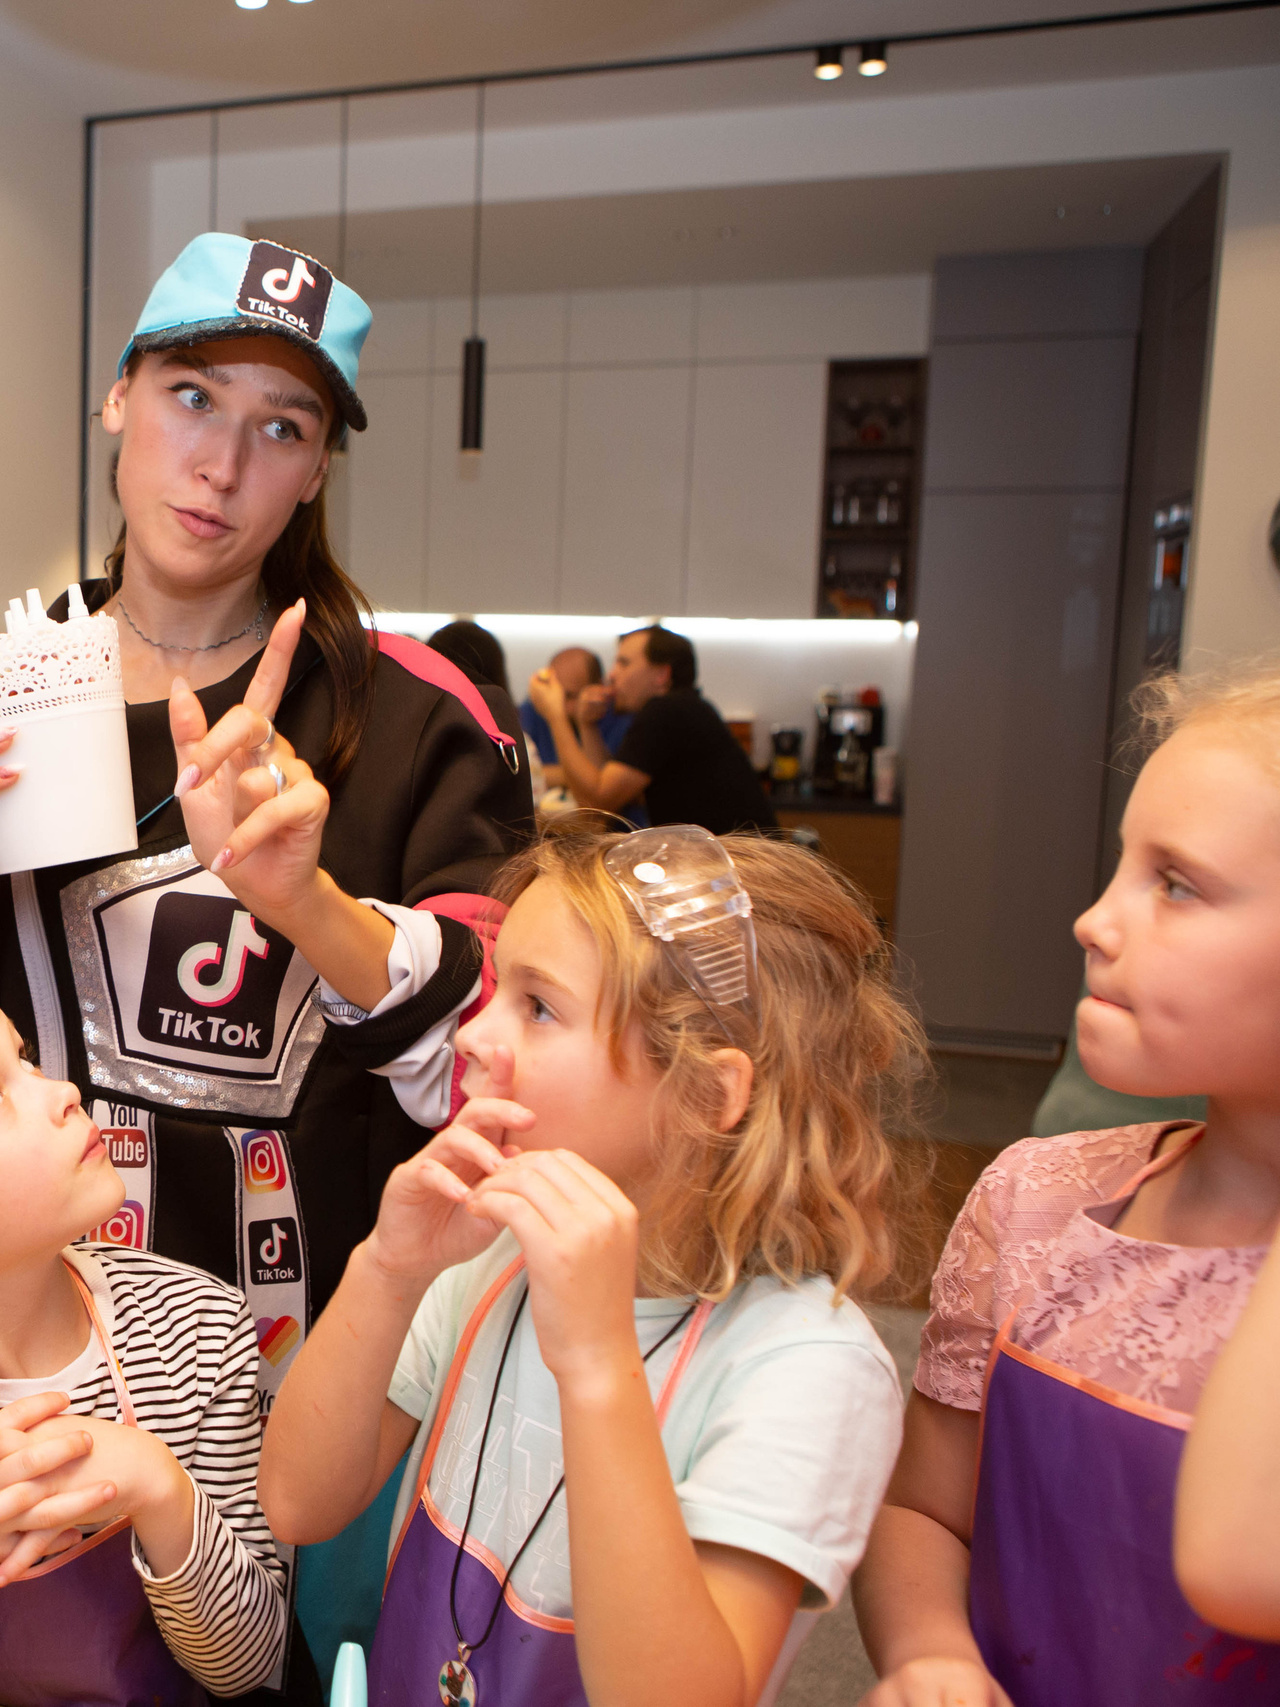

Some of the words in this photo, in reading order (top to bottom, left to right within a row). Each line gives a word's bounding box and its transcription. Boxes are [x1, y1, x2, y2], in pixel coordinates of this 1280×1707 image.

[248, 297, 309, 333] TikTok
[158, 1007, 261, 1049] TikTok
[107, 1102, 138, 1127] You
[101, 1134, 145, 1162] Tube
[257, 1267, 295, 1281] TikTok
